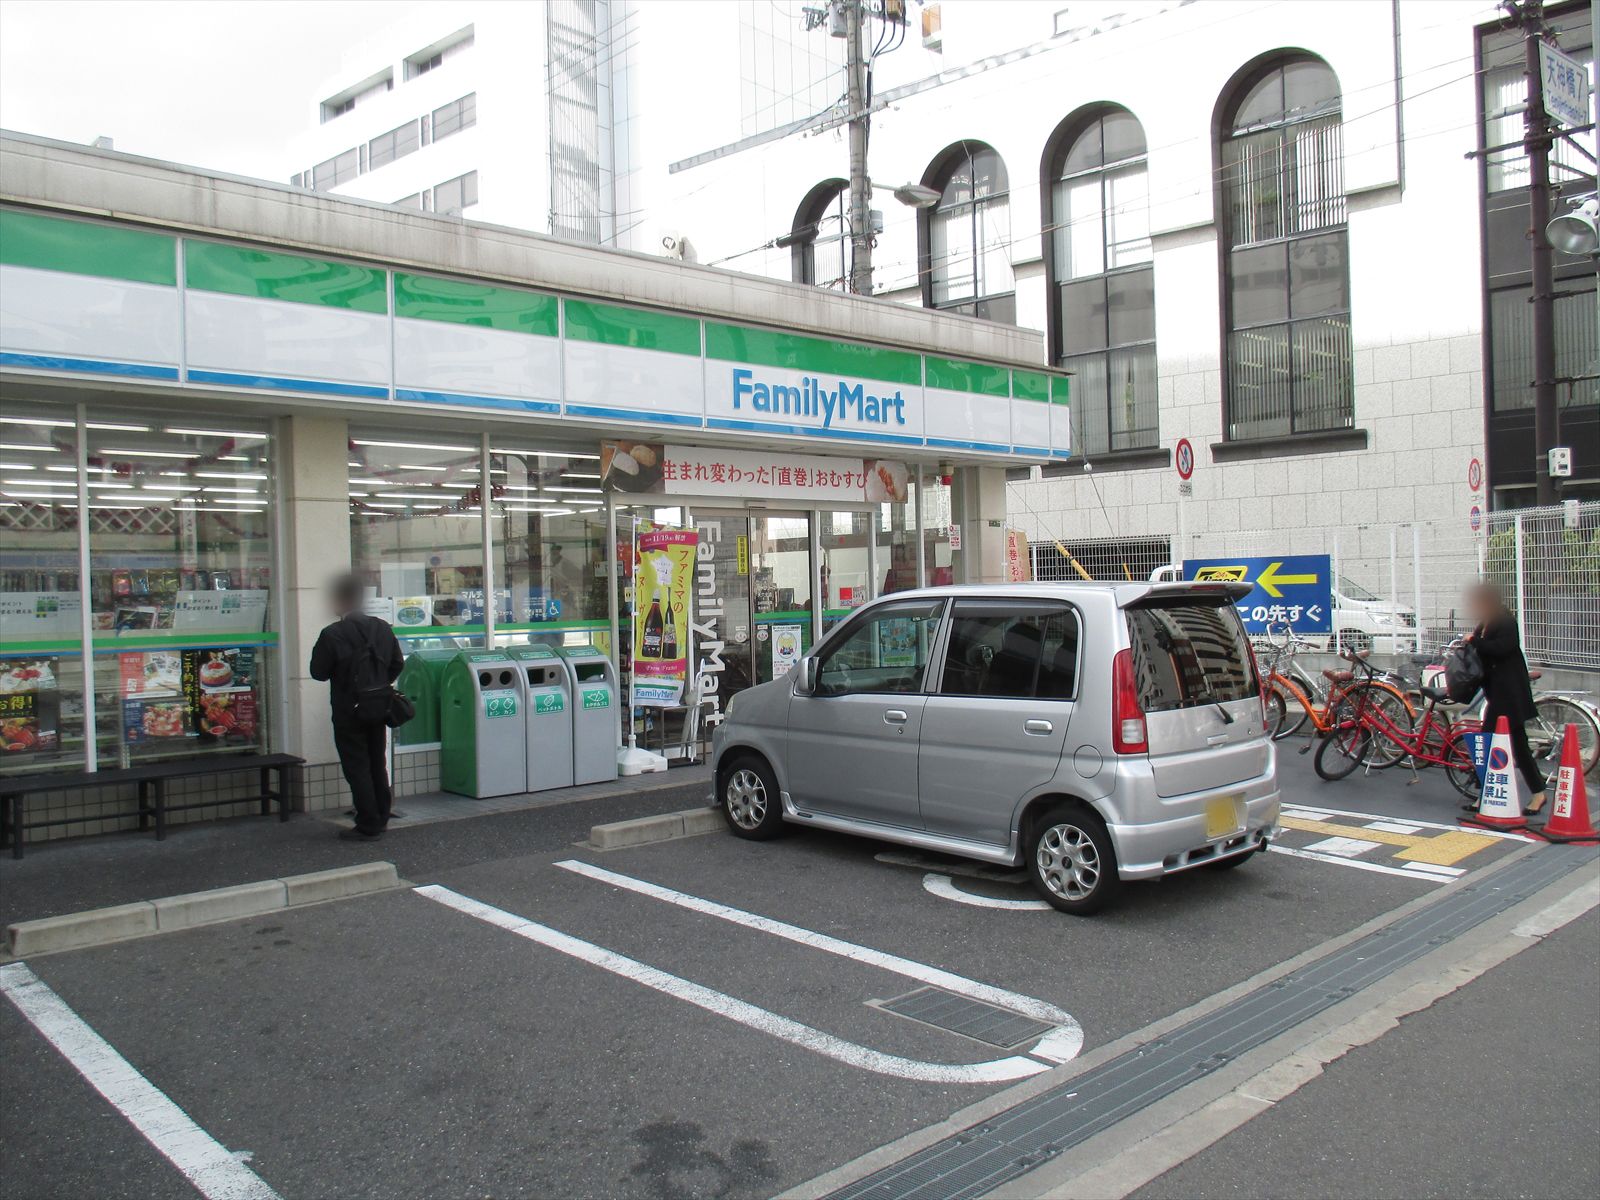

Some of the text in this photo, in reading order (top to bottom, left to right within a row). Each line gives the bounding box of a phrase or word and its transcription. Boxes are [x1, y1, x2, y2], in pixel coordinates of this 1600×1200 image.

[733, 368, 905, 428] FamilyMart
[661, 460, 868, 489] 生まれ変わった「直巻」おむすび
[694, 521, 725, 727] FamilyMart
[1238, 605, 1322, 622] この先すぐ
[1475, 736, 1484, 766] 駐車禁止
[1485, 786, 1507, 799] 禁止
[1557, 770, 1570, 814] 駐車禁止
